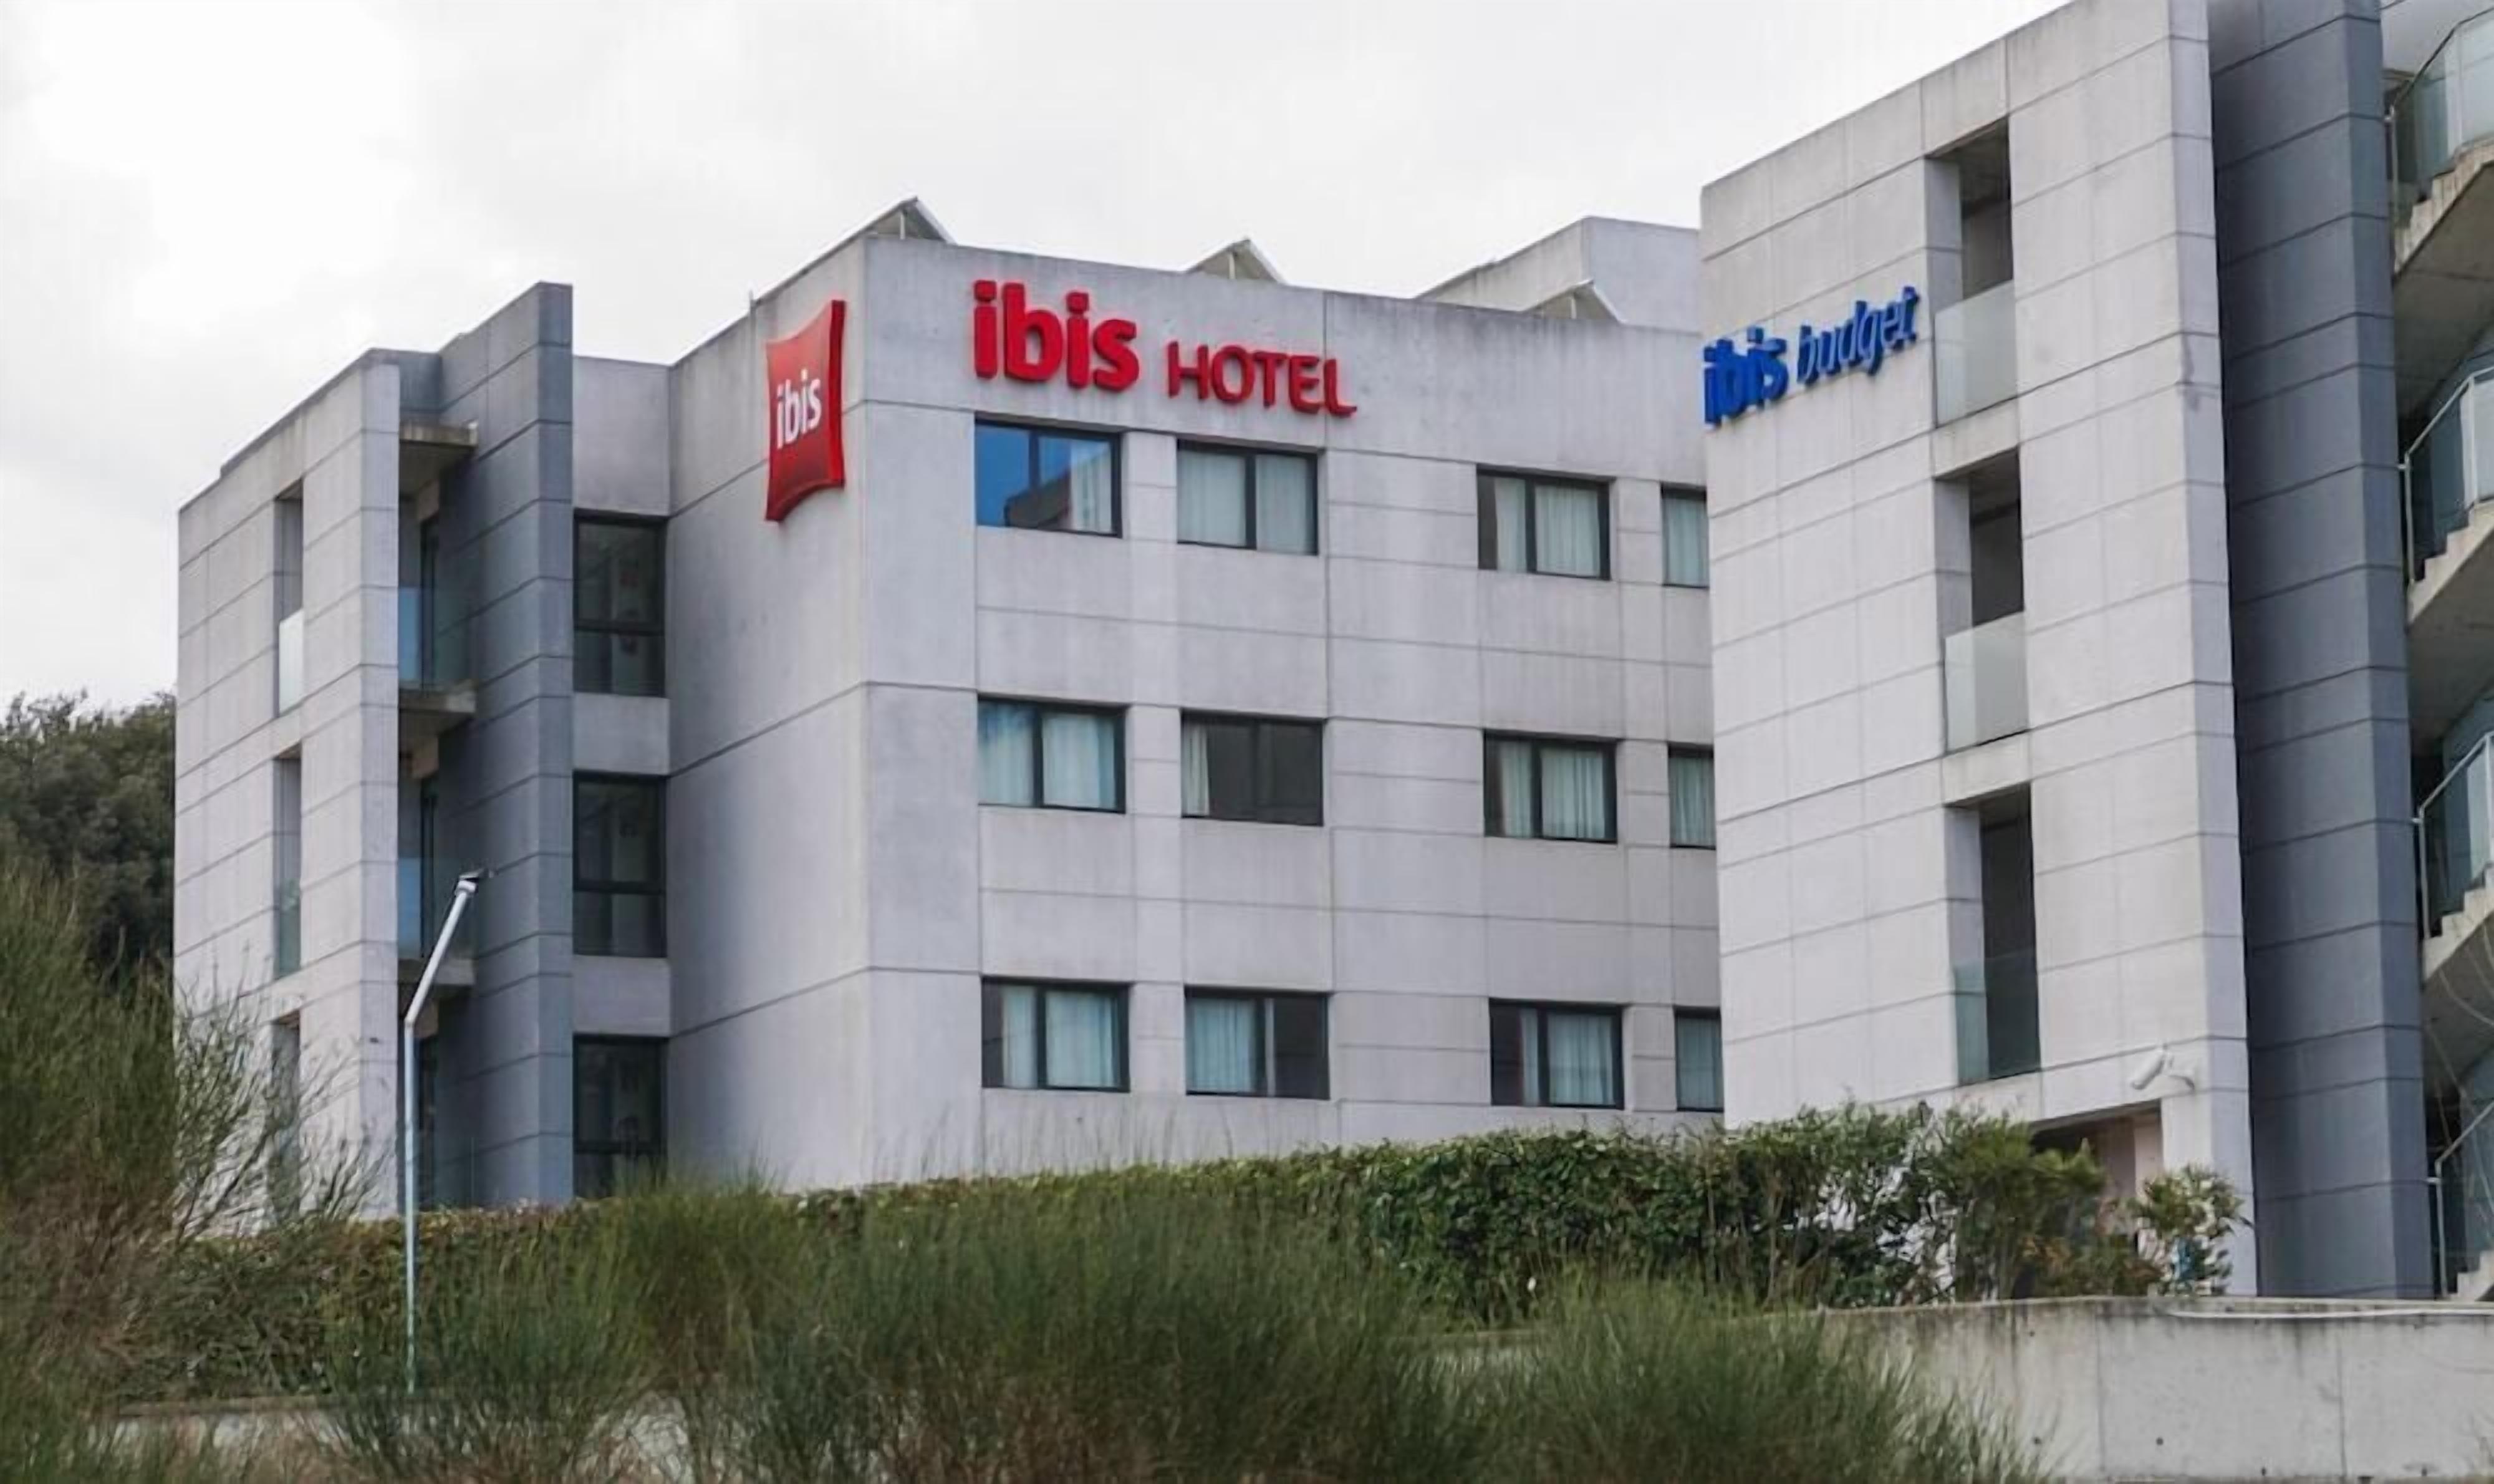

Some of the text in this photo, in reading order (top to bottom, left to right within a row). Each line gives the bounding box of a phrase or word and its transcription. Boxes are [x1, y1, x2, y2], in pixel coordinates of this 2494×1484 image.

[776, 368, 822, 449] ibis
[973, 280, 1355, 416] ibis HOTEL
[1703, 286, 1920, 425] ibis budget
